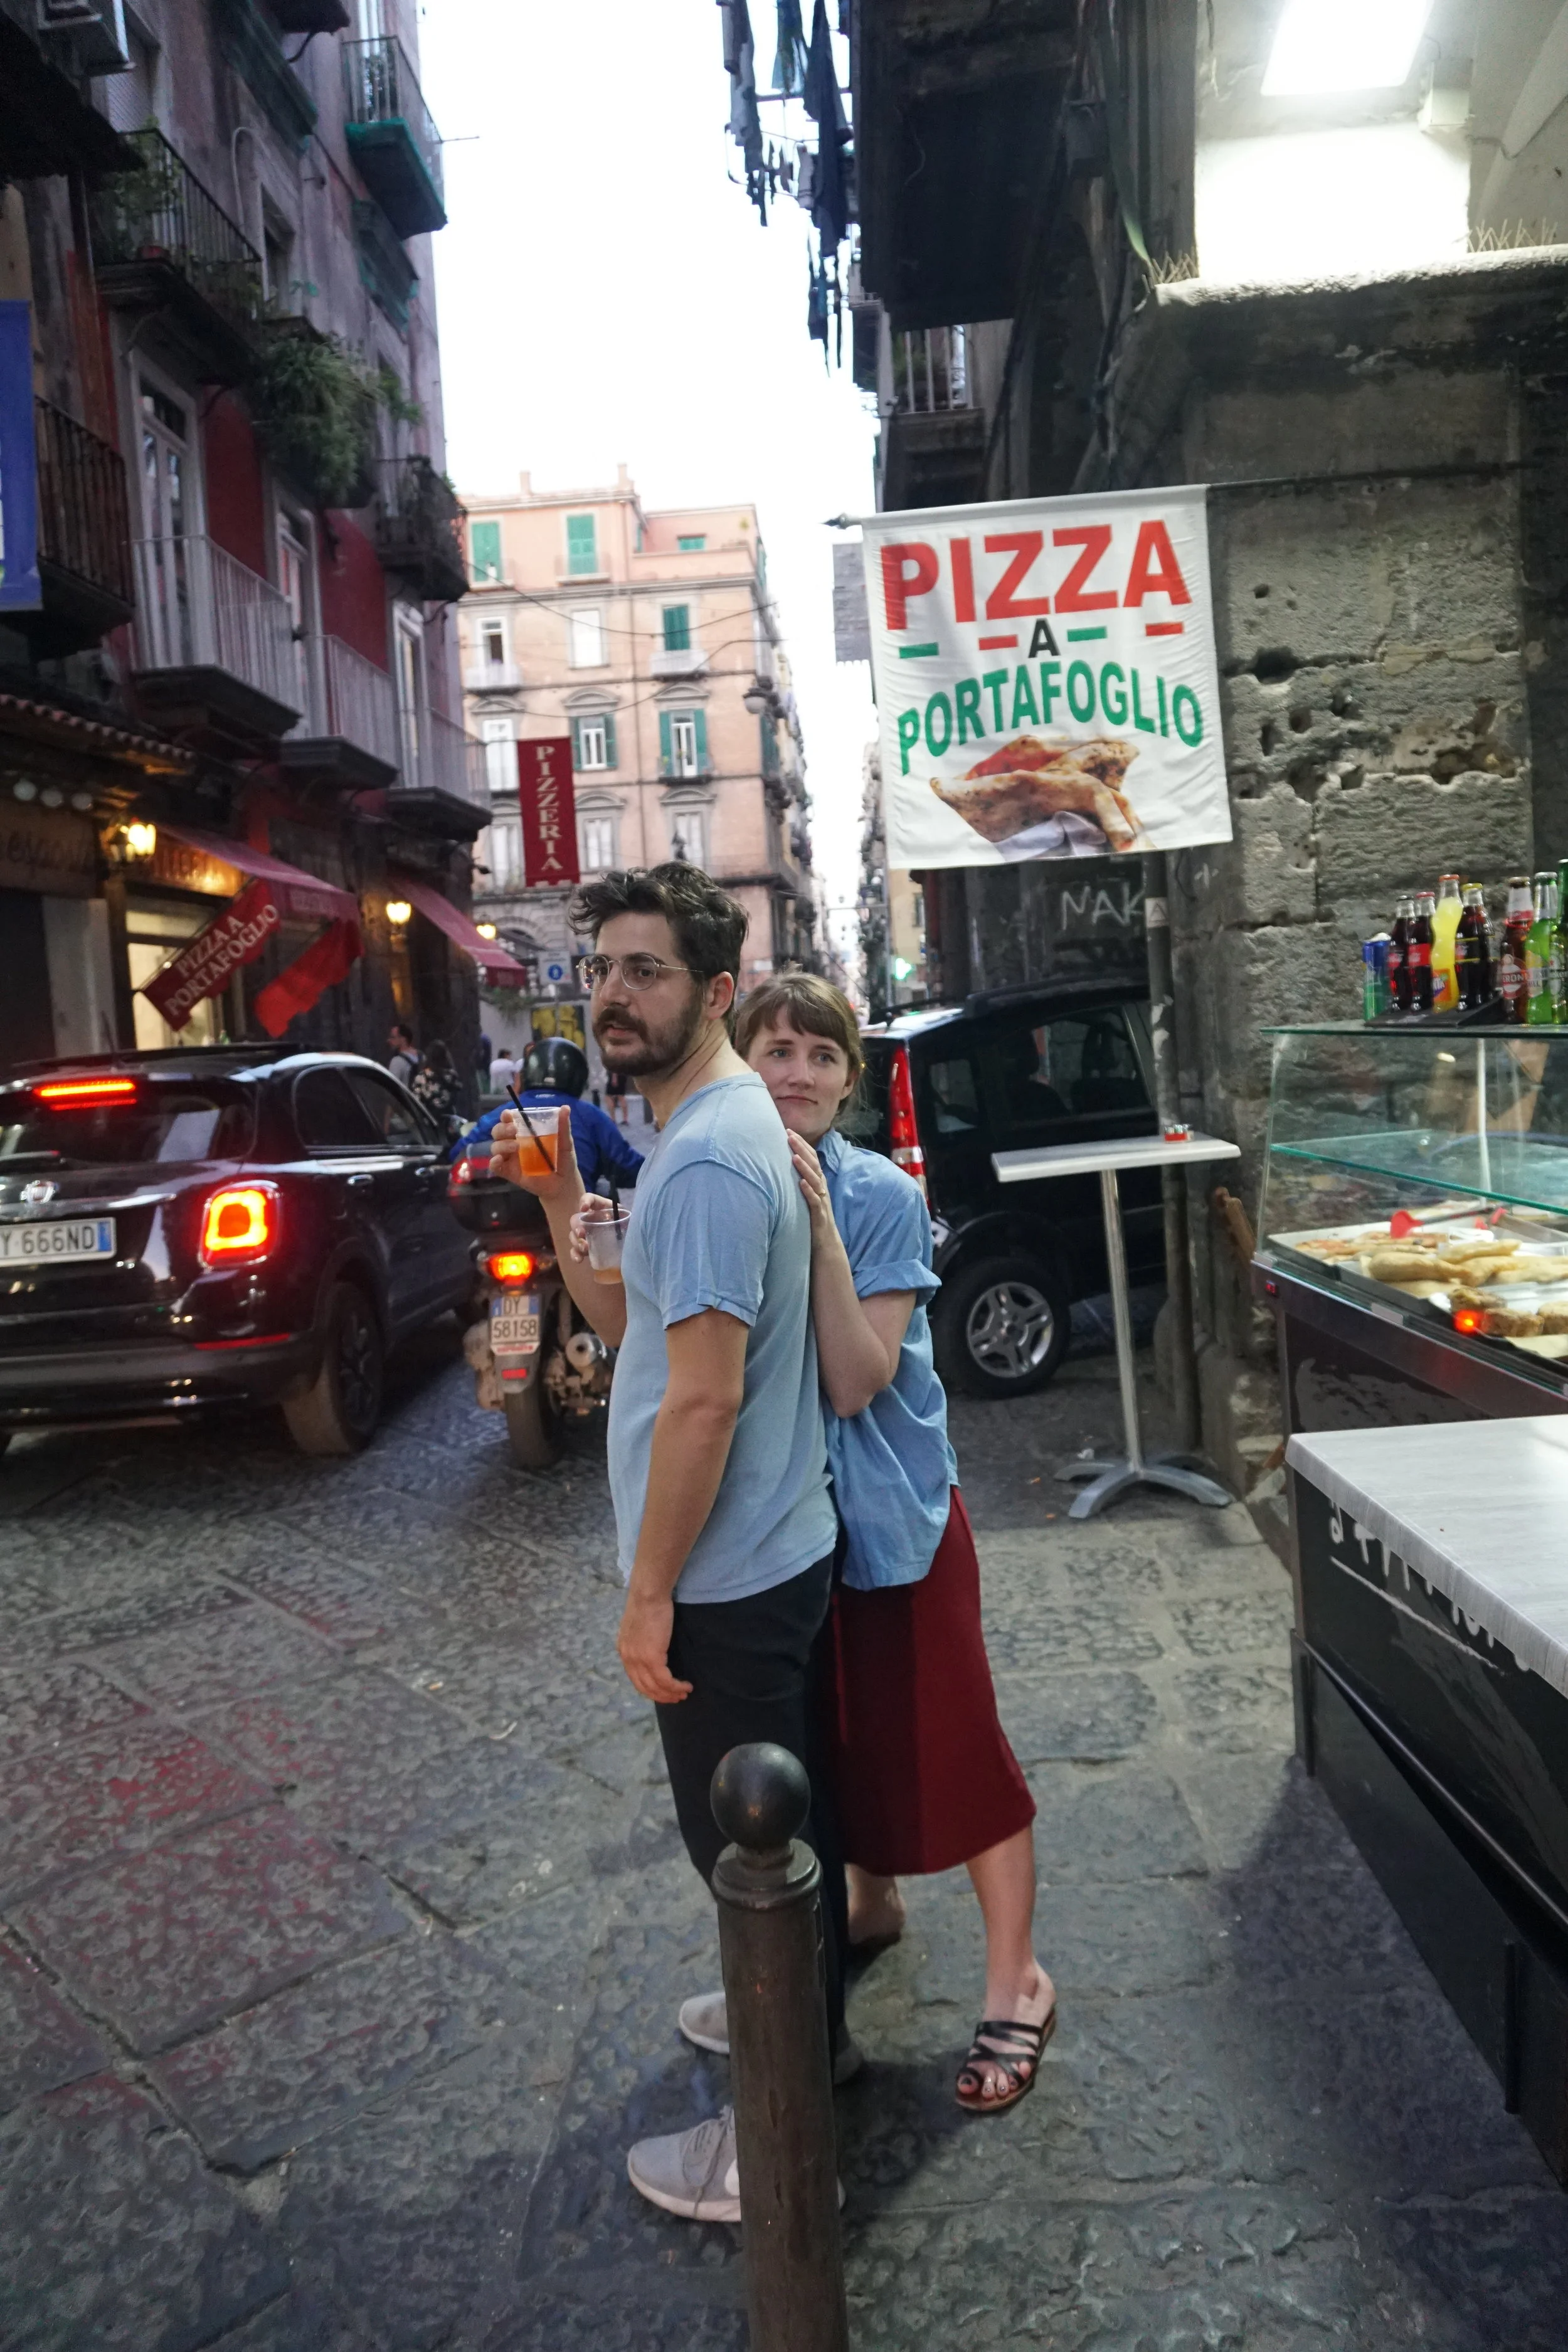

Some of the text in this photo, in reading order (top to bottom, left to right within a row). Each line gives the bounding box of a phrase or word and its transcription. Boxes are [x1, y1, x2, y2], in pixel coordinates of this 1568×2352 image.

[880, 520, 1192, 630] PIZZA
[1028, 618, 1061, 659] A
[897, 660, 1204, 776] PORTAFOGLIO
[536, 745, 563, 871] PIZZERIA
[164, 904, 279, 1016] PORTAFOGLIO
[175, 916, 245, 978] PIZZA A
[22, 1225, 95, 1254] 666ND
[493, 1319, 537, 1338] 58158
